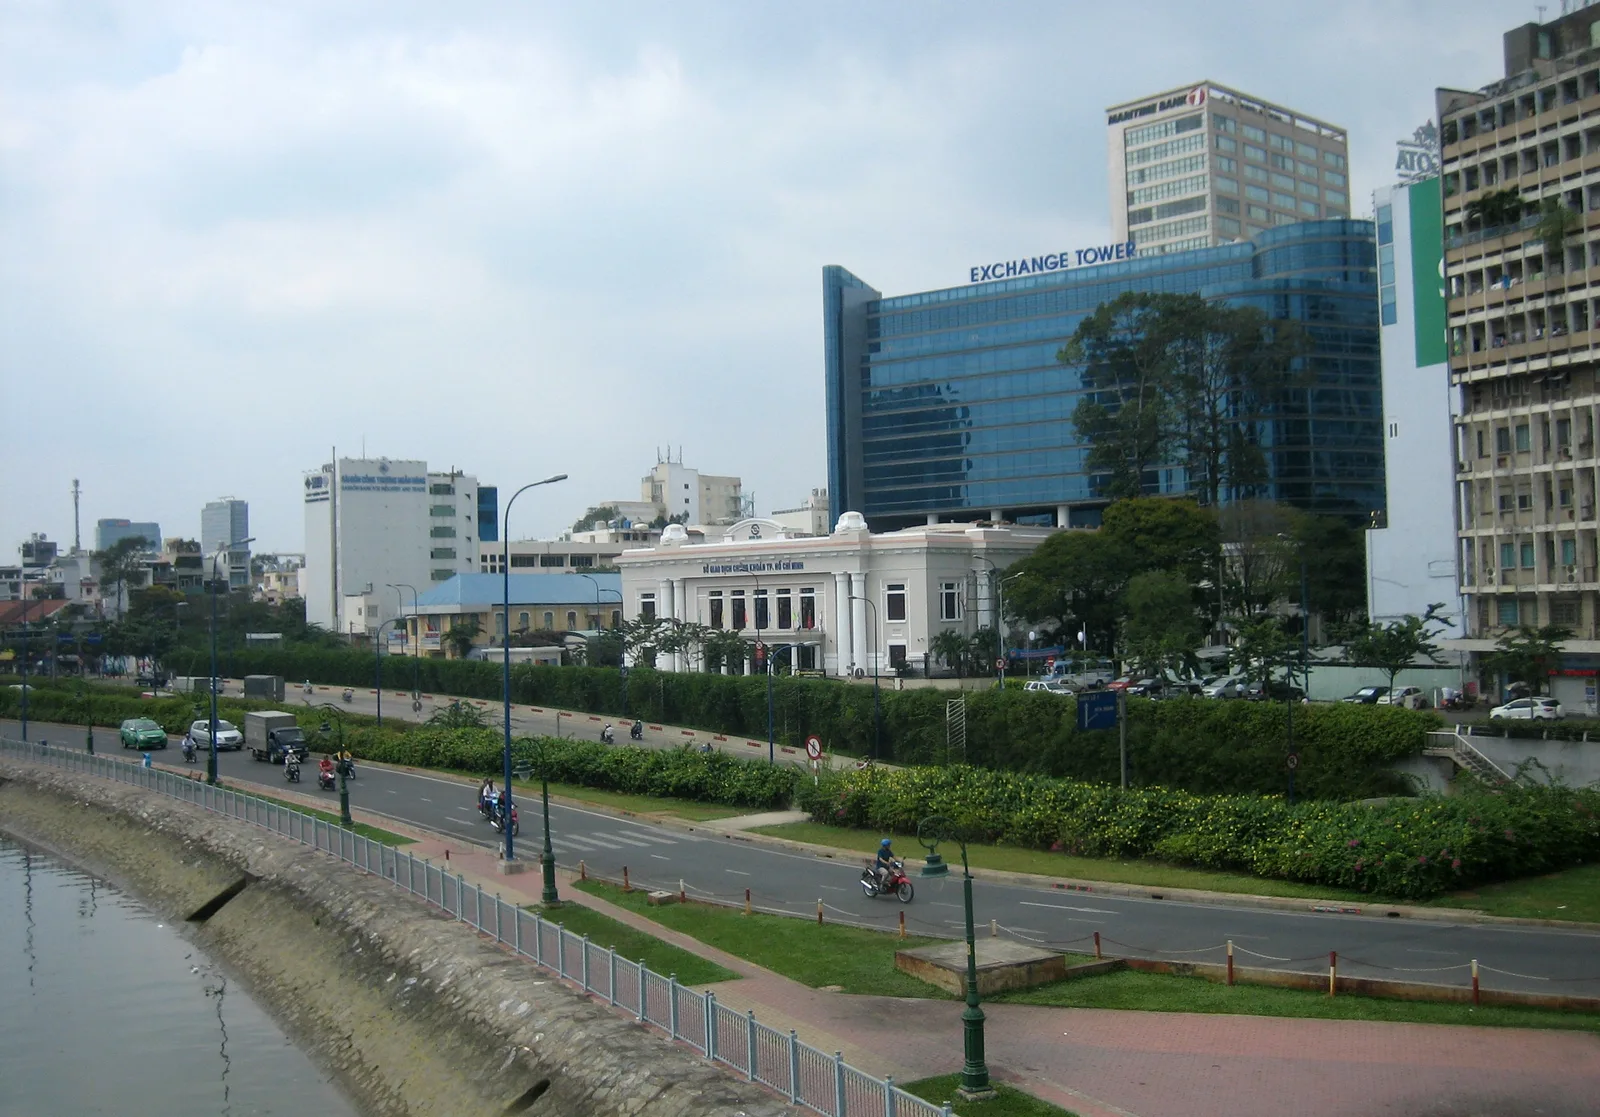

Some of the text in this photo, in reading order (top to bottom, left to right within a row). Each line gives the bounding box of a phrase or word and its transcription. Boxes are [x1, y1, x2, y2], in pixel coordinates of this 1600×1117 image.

[1108, 94, 1187, 126] MARITIME BANK
[970, 240, 1137, 283] EXCHANGE TOWER
